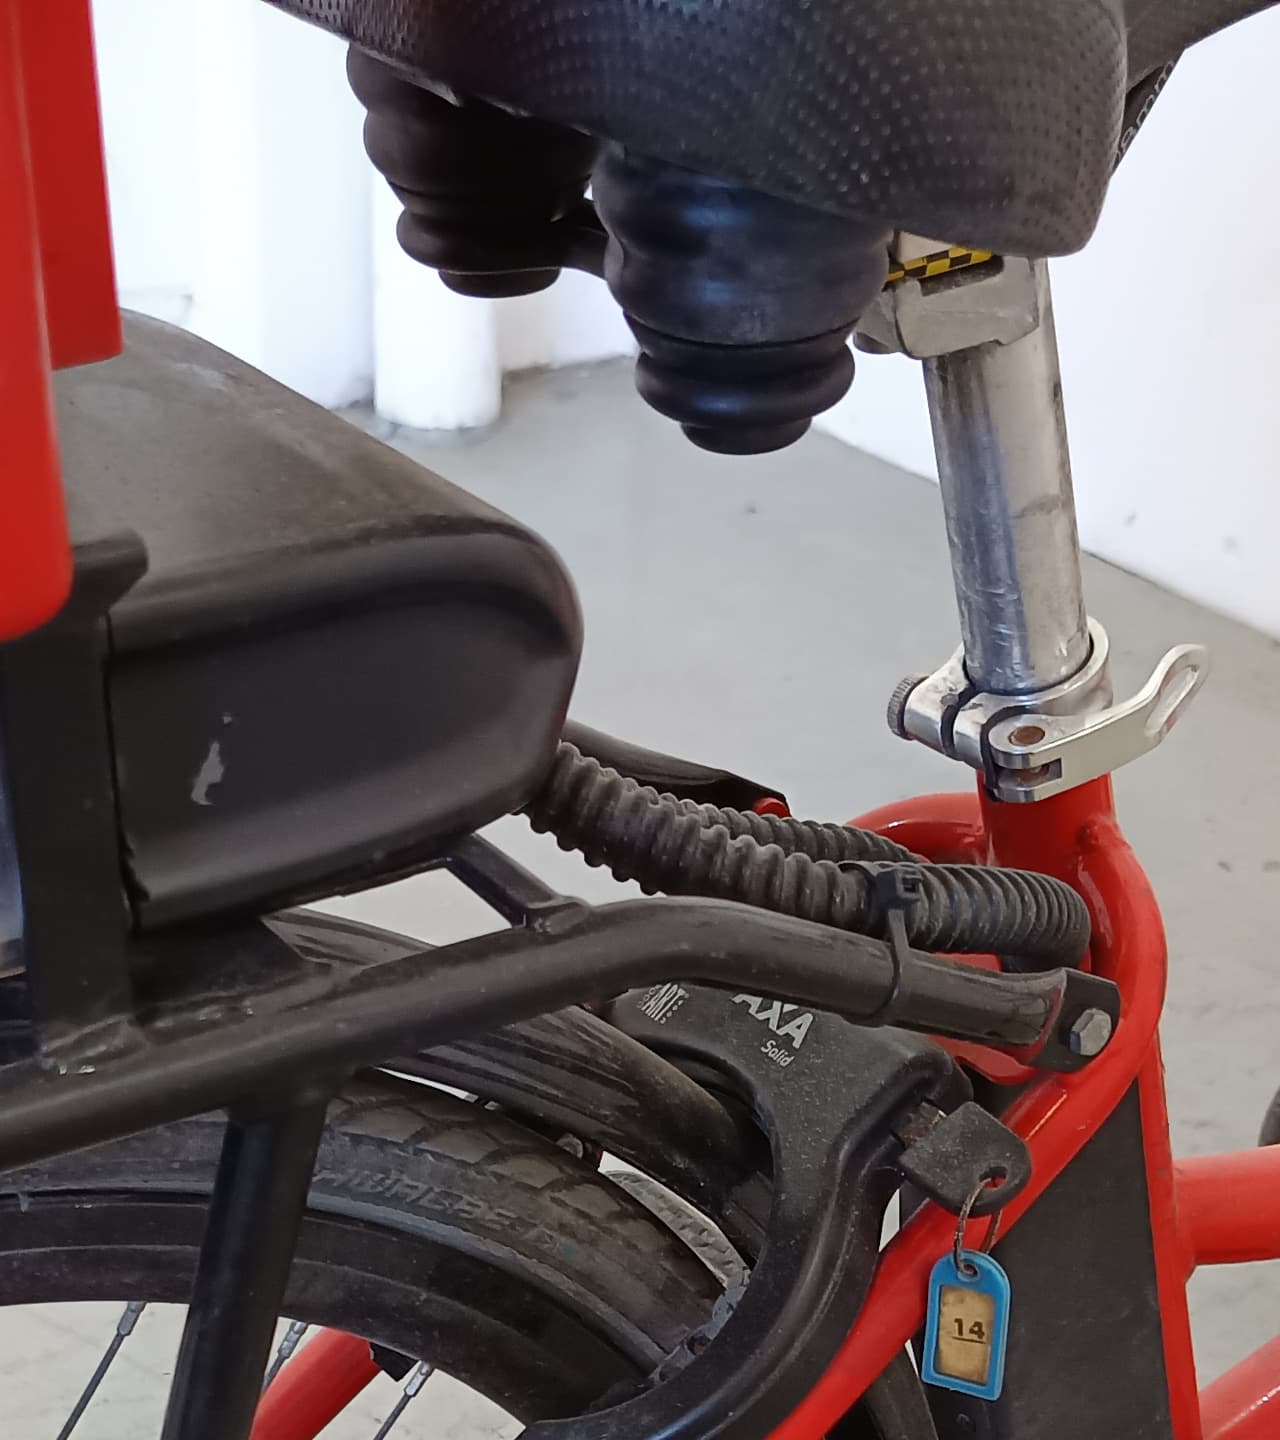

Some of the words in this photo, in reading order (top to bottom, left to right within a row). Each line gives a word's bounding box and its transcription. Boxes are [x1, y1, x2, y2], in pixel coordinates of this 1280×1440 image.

[640, 982, 690, 1022] ART
[731, 993, 814, 1049] AXA
[761, 1039, 795, 1068] Solid
[954, 1317, 986, 1340] 14
